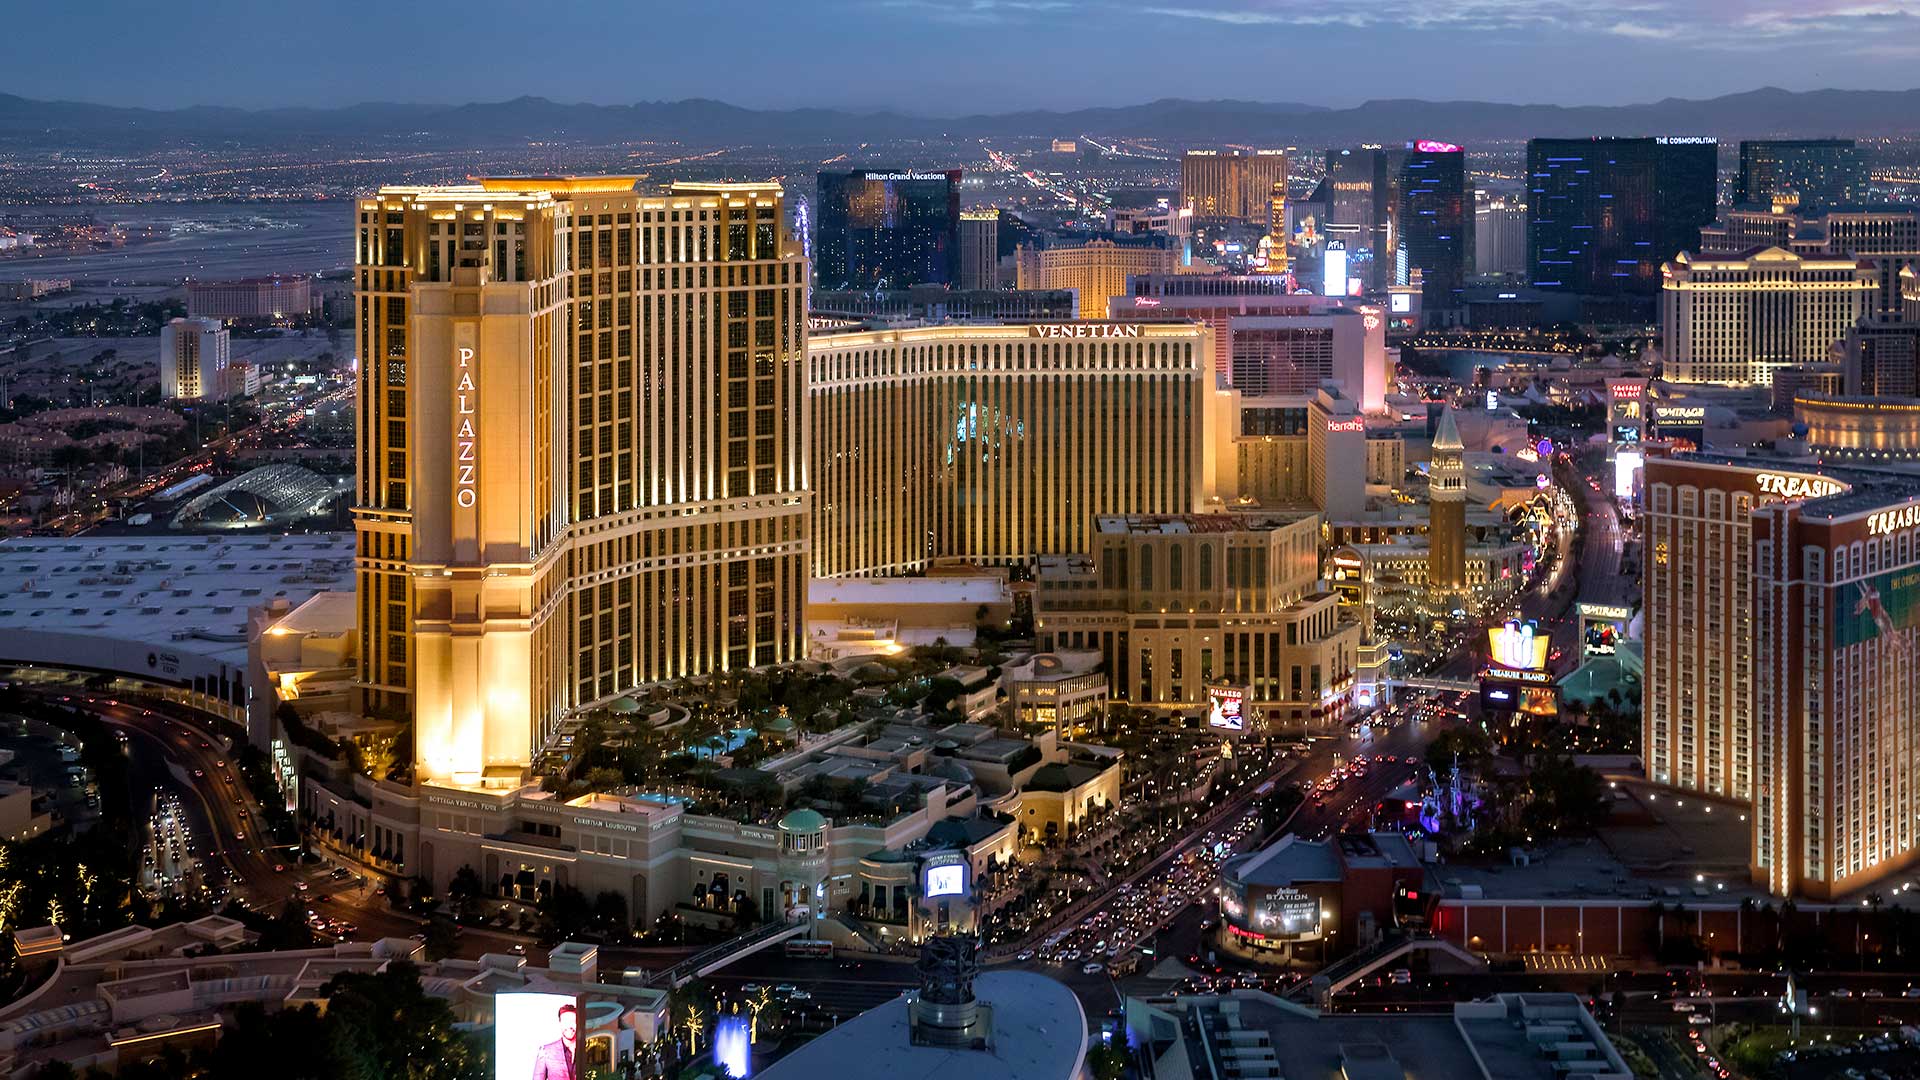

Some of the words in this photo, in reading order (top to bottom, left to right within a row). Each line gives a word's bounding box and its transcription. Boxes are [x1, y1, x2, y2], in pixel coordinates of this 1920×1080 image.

[1656, 137, 1668, 145] THE
[1669, 137, 1717, 145] COSMOPOLITAN
[889, 172, 911, 180] Grand
[1034, 324, 1140, 338] VENETIAN
[457, 348, 476, 508] PALAZZO
[1490, 669, 1520, 679] TREASURE
[1522, 672, 1546, 682] ISLAND
[1265, 893, 1309, 901] STATION
